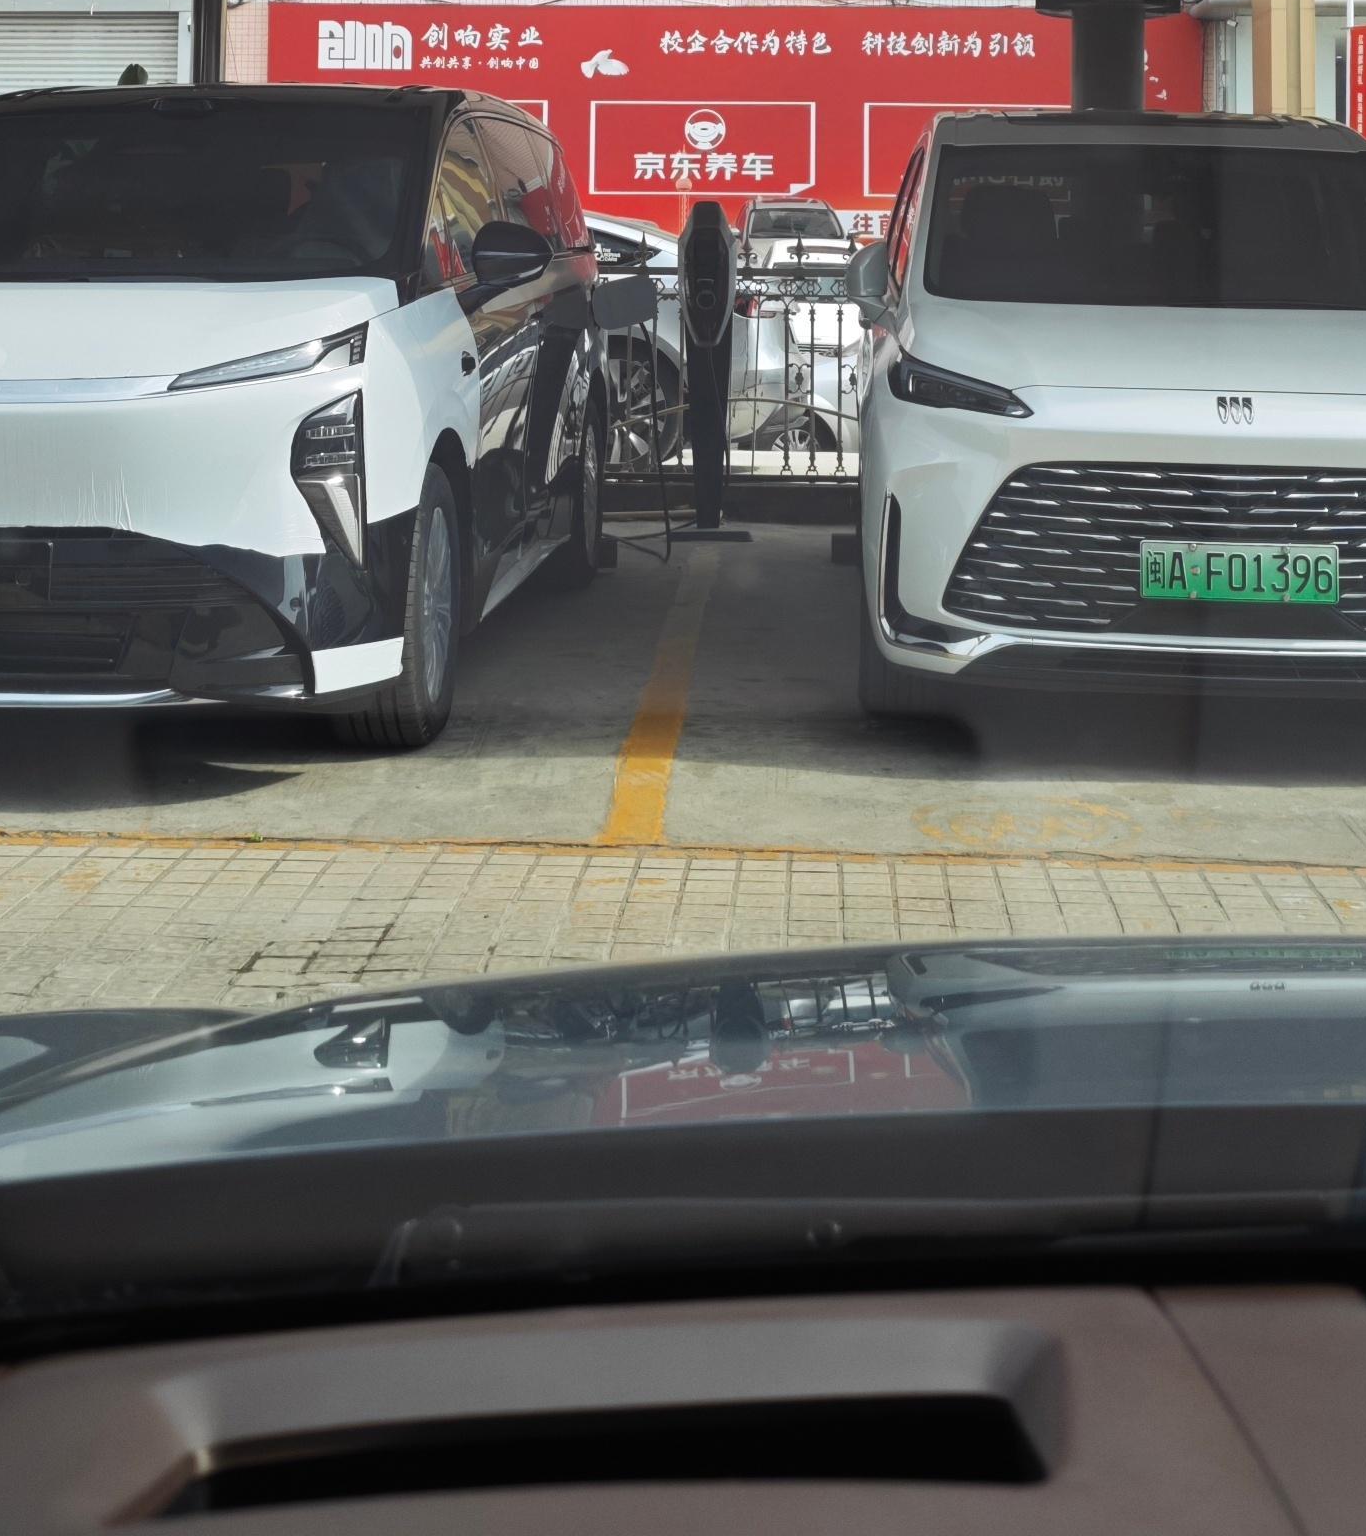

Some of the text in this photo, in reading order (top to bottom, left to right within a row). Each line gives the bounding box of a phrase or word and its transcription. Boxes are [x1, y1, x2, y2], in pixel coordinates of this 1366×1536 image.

[421, 23, 543, 51] 创响实业
[659, 29, 832, 56] 校企合作为特色
[634, 152, 774, 181] 京东养车
